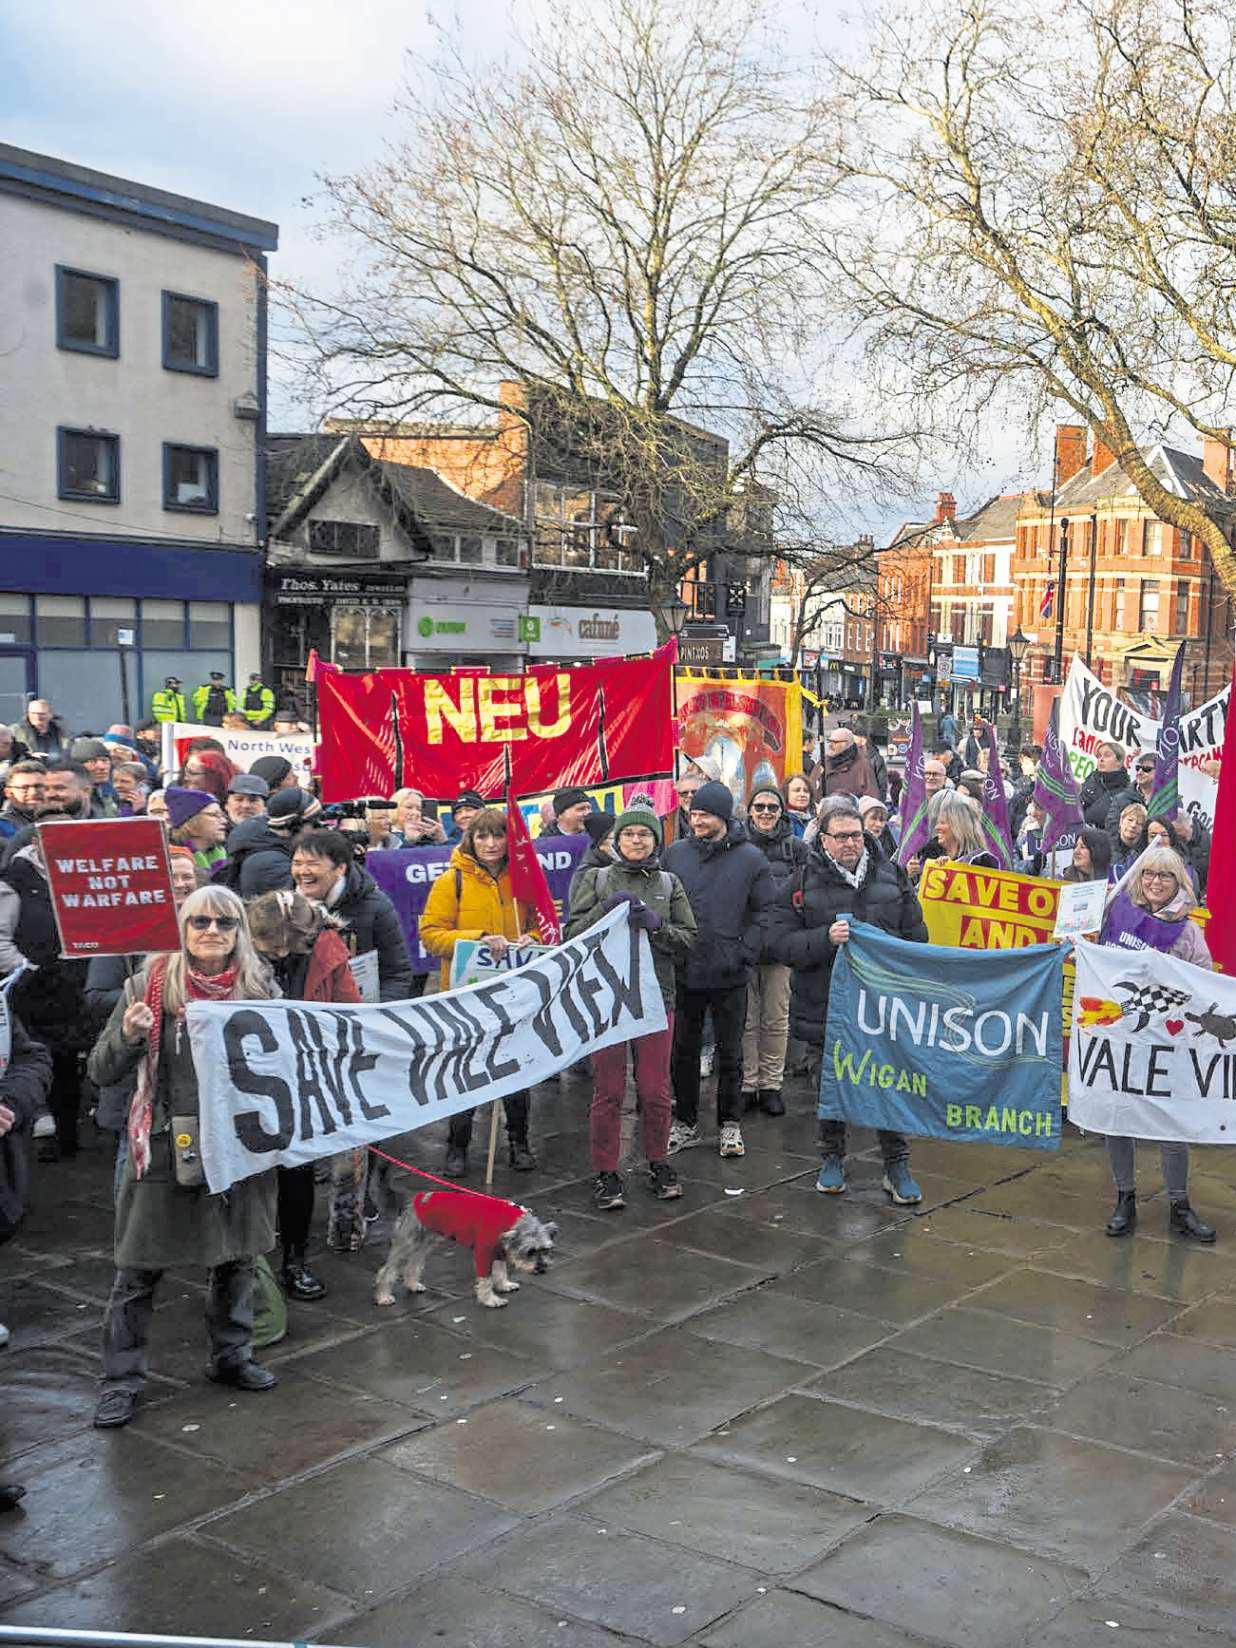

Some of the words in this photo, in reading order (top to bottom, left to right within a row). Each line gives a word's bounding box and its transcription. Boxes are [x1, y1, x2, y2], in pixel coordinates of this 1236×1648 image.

[321, 579, 360, 592] Yates
[423, 673, 571, 745] NEU
[1081, 677, 1142, 748] YOUR
[228, 739, 274, 752] North
[279, 741, 310, 754] Wes
[55, 855, 160, 874] WELFARE
[61, 889, 167, 908] WARFARE
[88, 875, 131, 890] NOT
[923, 869, 1019, 912] SAVE
[961, 914, 1038, 949] AND
[223, 1009, 391, 1154] SAVE
[380, 983, 521, 1107] VALE
[518, 924, 645, 1057] VIEW
[857, 988, 1050, 1058] UNISON
[1077, 1035, 1174, 1098] VALE
[945, 1104, 1052, 1137] BRANCH
